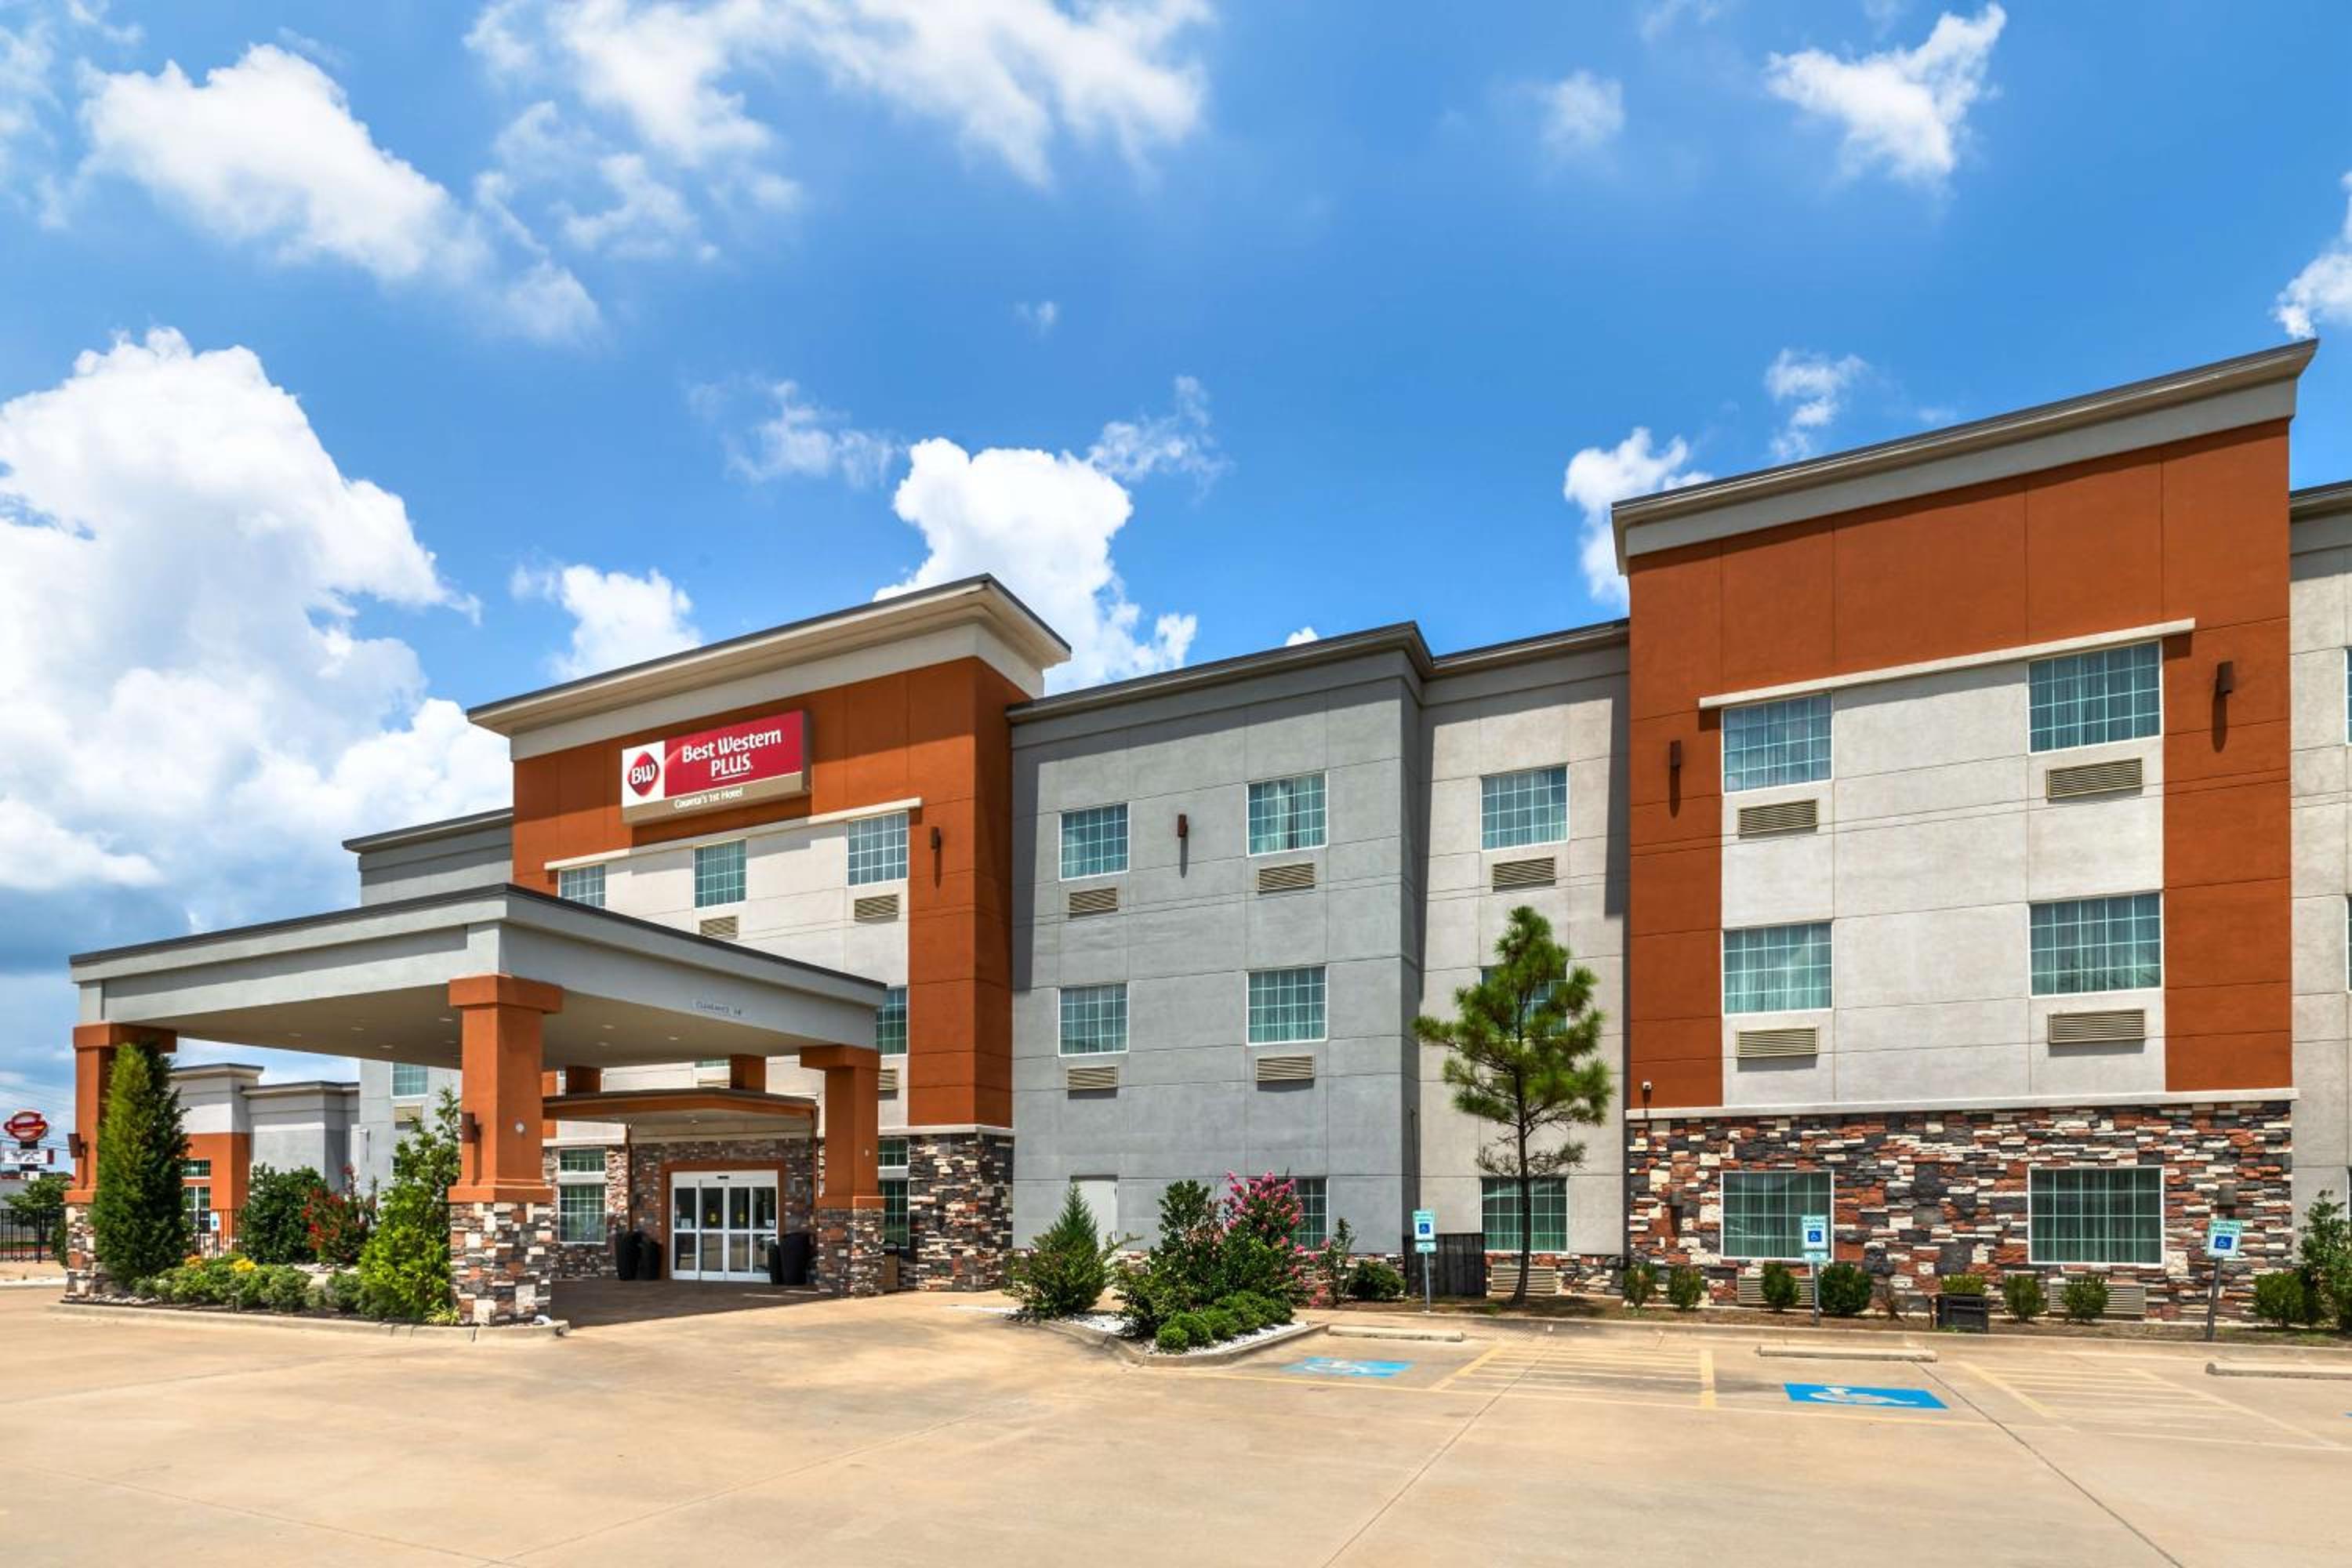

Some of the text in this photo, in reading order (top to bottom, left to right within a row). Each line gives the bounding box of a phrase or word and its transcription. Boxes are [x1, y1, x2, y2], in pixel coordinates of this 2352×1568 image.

[682, 728, 782, 763] Best Western
[631, 763, 656, 785] BW
[711, 753, 751, 777] PLUS
